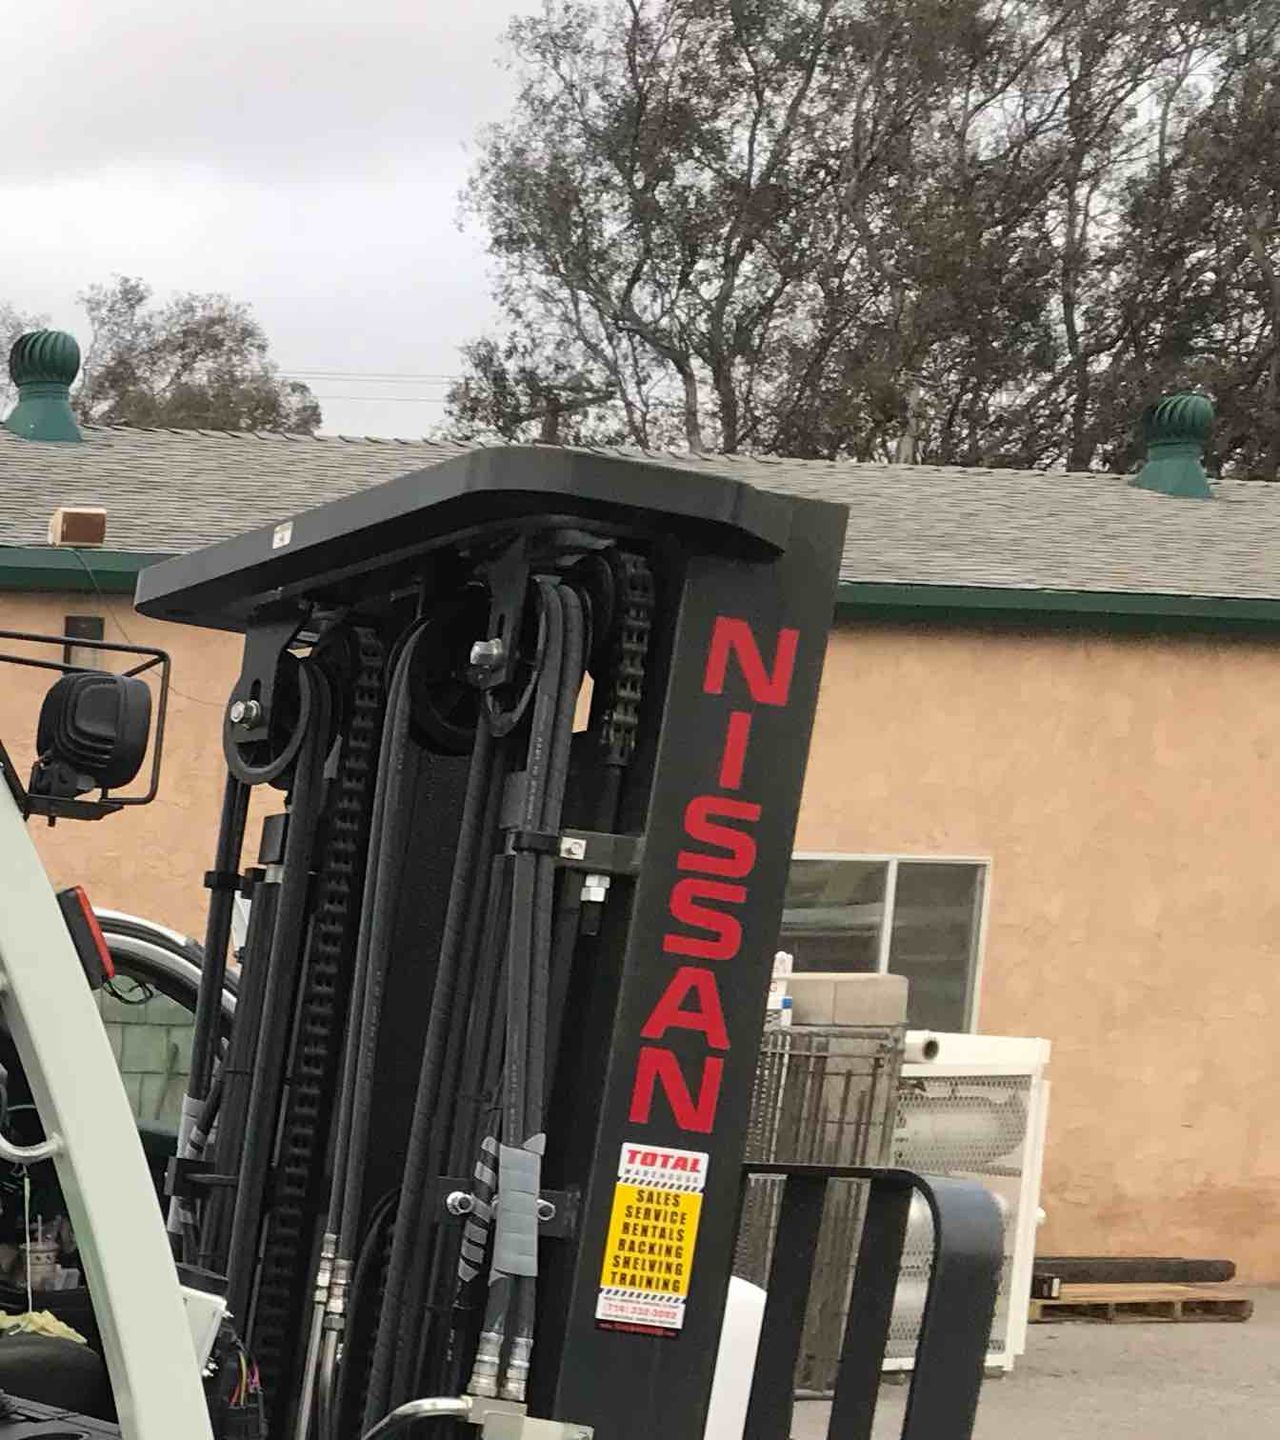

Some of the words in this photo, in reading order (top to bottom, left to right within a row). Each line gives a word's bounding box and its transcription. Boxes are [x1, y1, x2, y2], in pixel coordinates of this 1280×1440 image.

[629, 615, 800, 1135] NISSAN
[626, 1149, 702, 1173] TOTAL
[636, 1189, 680, 1207] SALES
[625, 1205, 687, 1225] SERVICE
[622, 1222, 685, 1242] RENTALS
[612, 1255, 683, 1276] SHELVING
[610, 1271, 681, 1293] TRAINING
